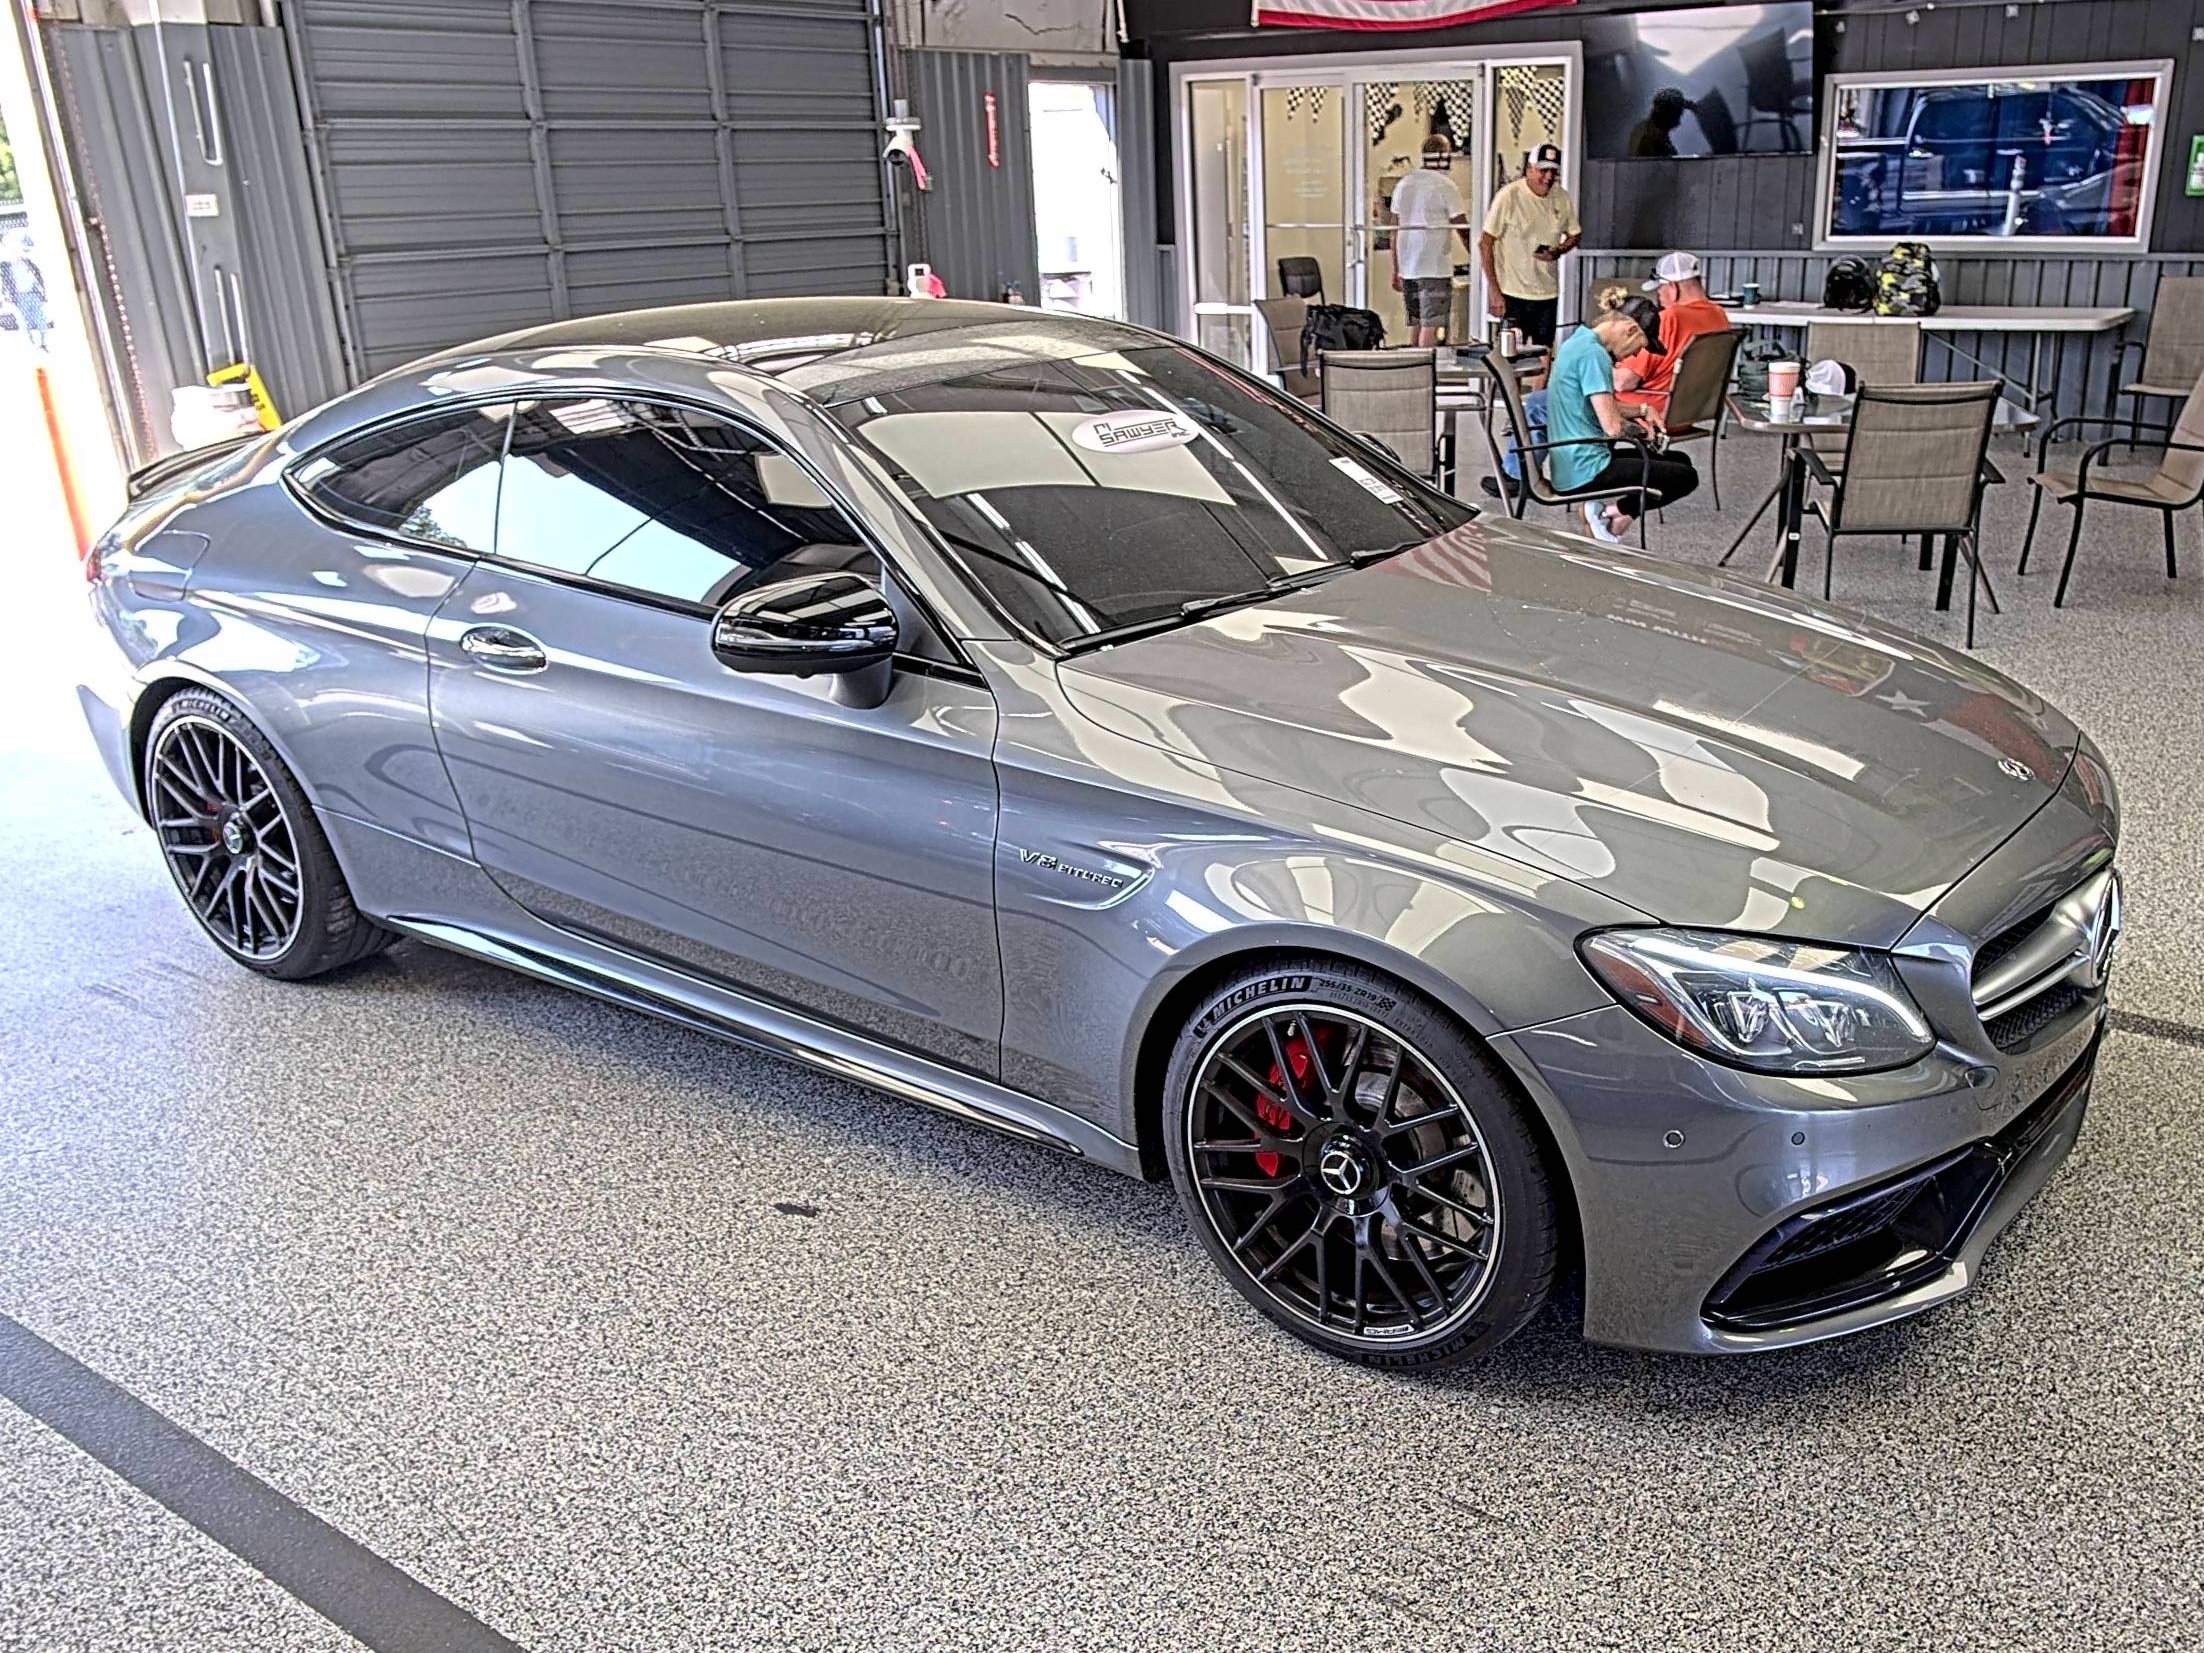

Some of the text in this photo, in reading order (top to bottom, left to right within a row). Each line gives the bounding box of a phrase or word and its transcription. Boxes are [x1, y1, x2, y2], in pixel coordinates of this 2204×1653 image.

[1098, 420, 1187, 445] SAWYER
[1019, 848, 1057, 869] V8
[1212, 976, 1306, 1020] MICHELIN
[1318, 979, 1378, 1001] 255/35 ZR19
